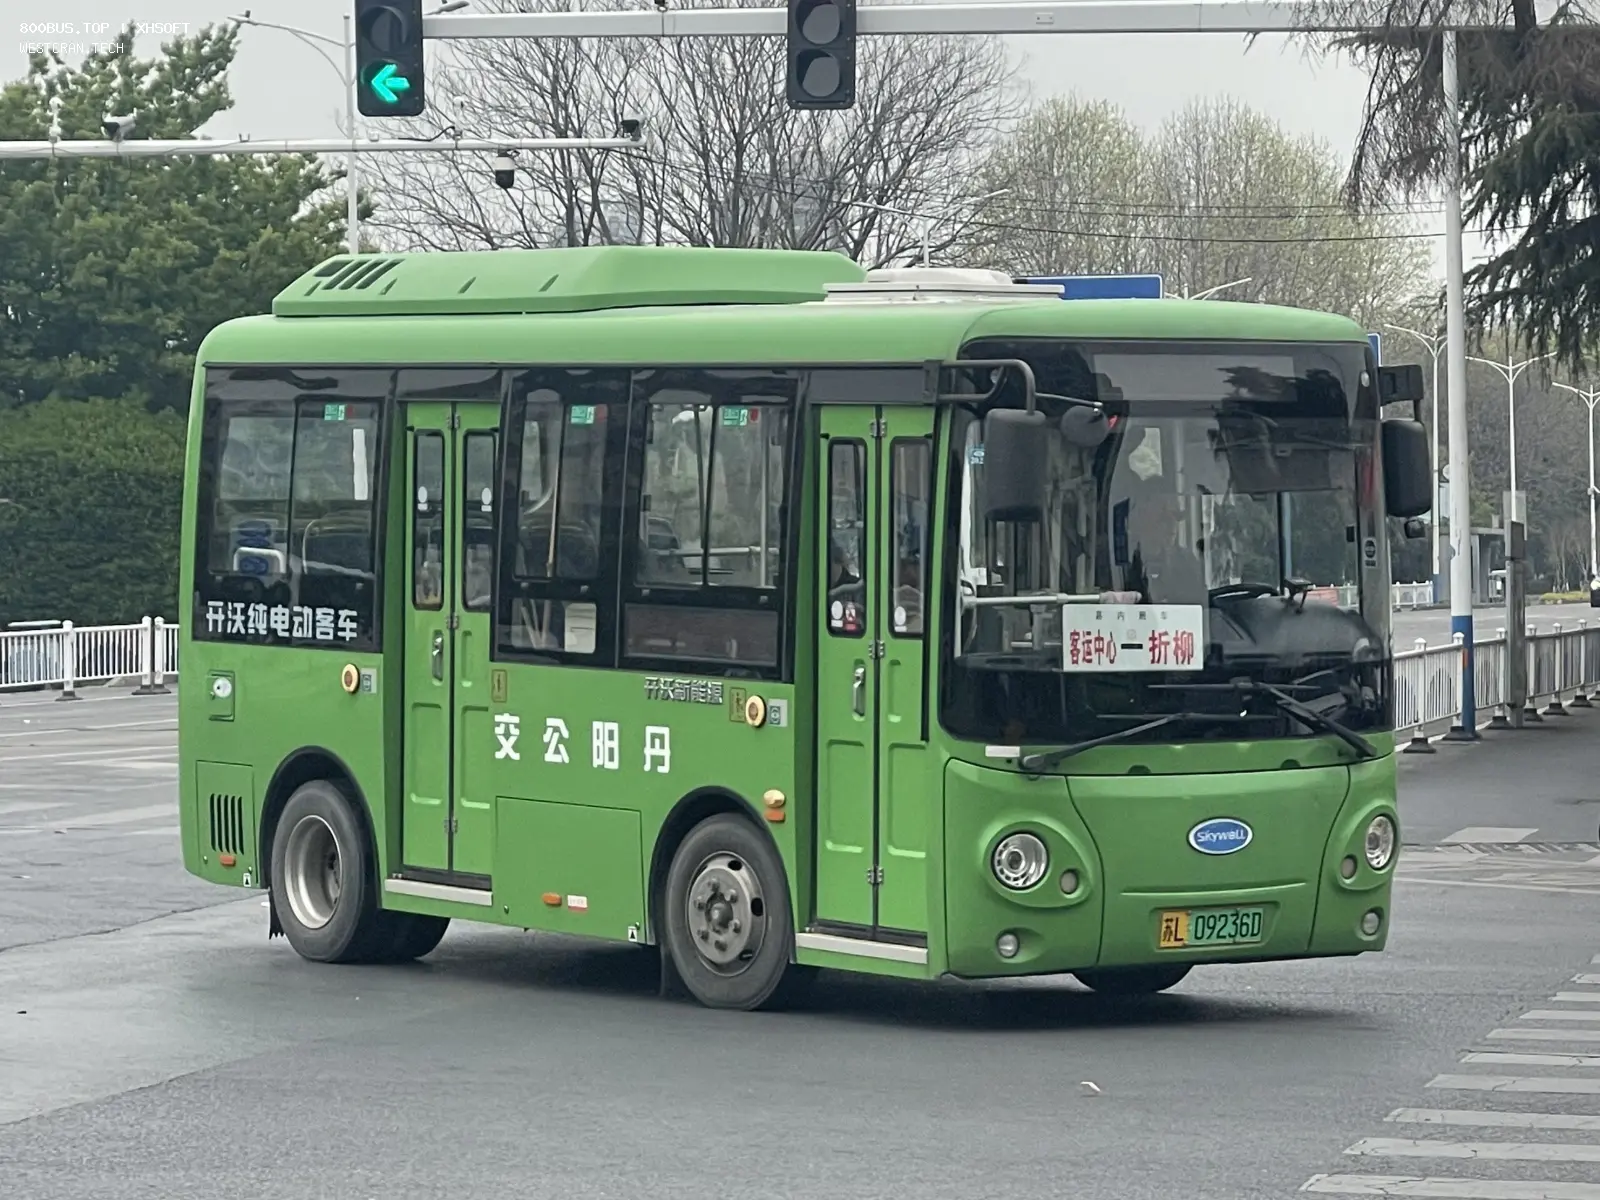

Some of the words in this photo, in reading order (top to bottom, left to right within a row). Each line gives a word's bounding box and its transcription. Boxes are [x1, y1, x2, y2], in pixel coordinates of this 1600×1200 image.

[205, 600, 358, 642] 开沃纯电动客车
[643, 676, 724, 705] 开沃新能源
